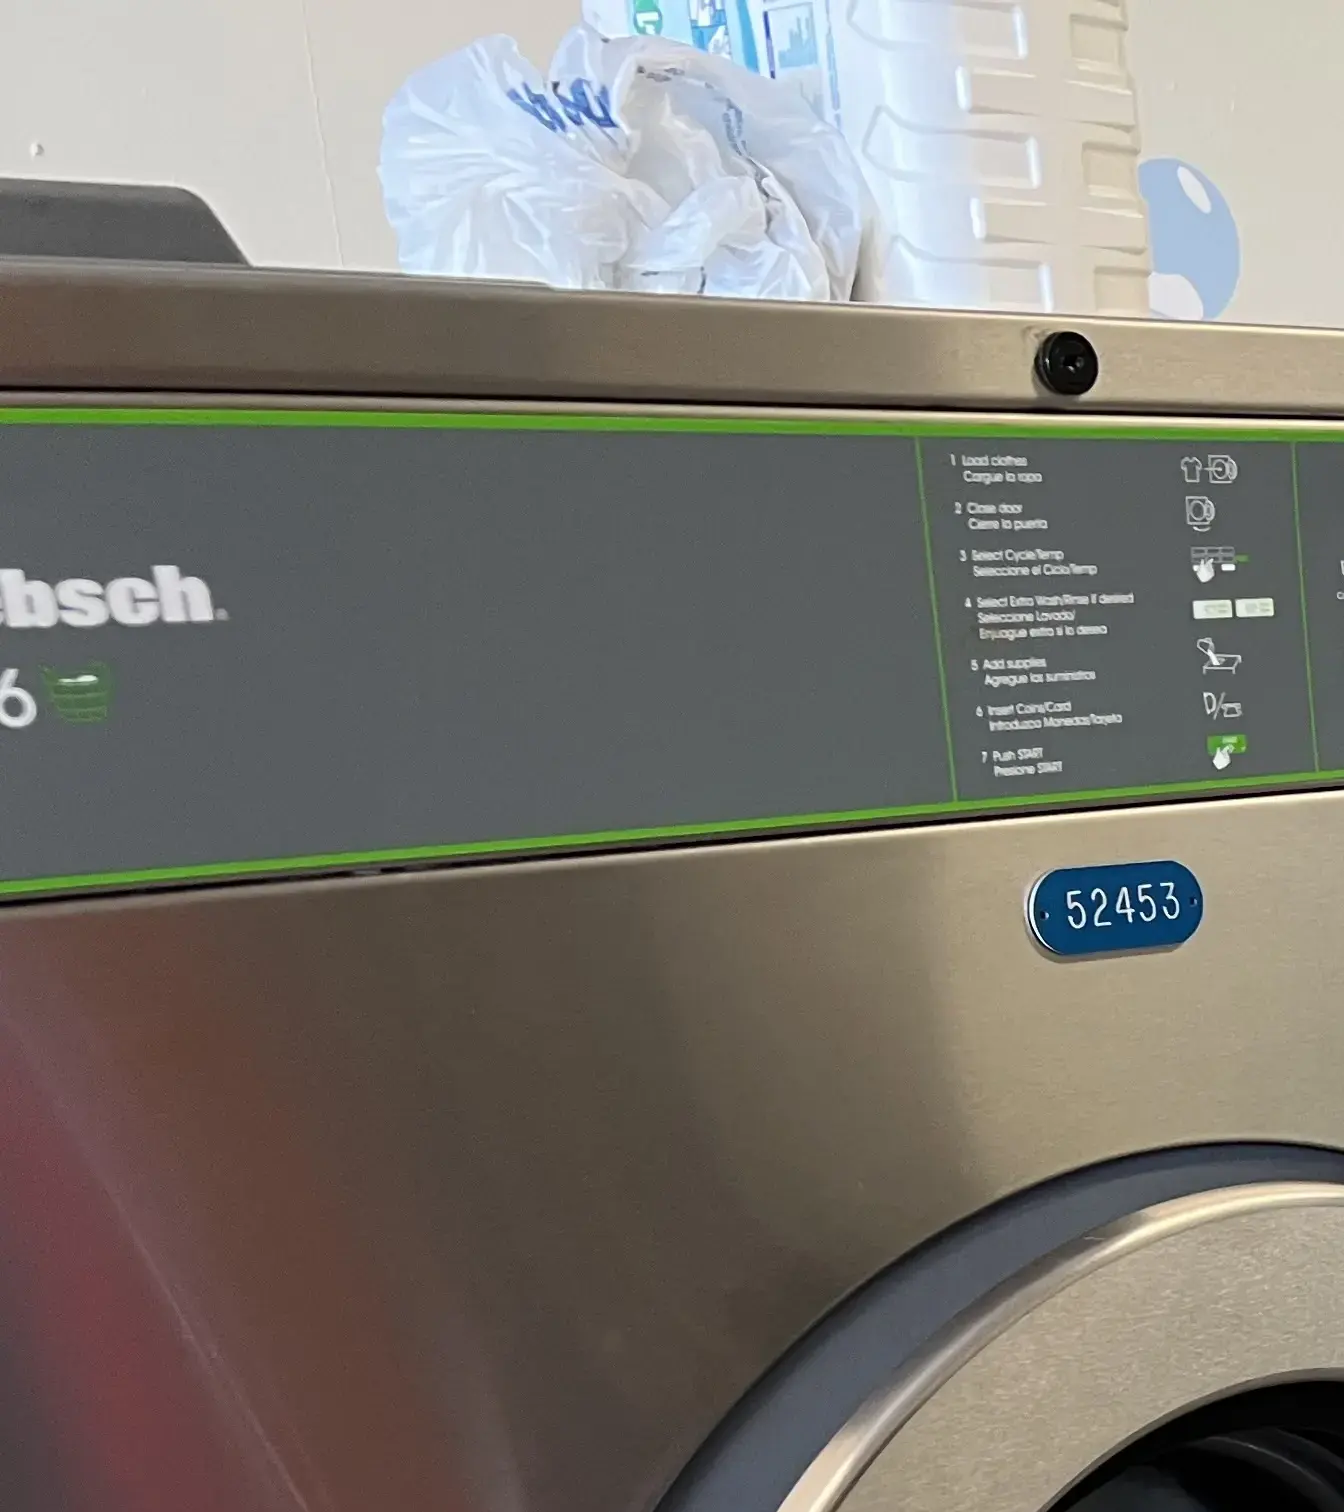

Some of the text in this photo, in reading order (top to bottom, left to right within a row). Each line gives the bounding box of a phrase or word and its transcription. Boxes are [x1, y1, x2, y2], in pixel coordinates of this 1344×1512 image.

[0, 565, 214, 629] bsch
[0, 668, 38, 729] 6
[1066, 882, 1181, 930] 52453
